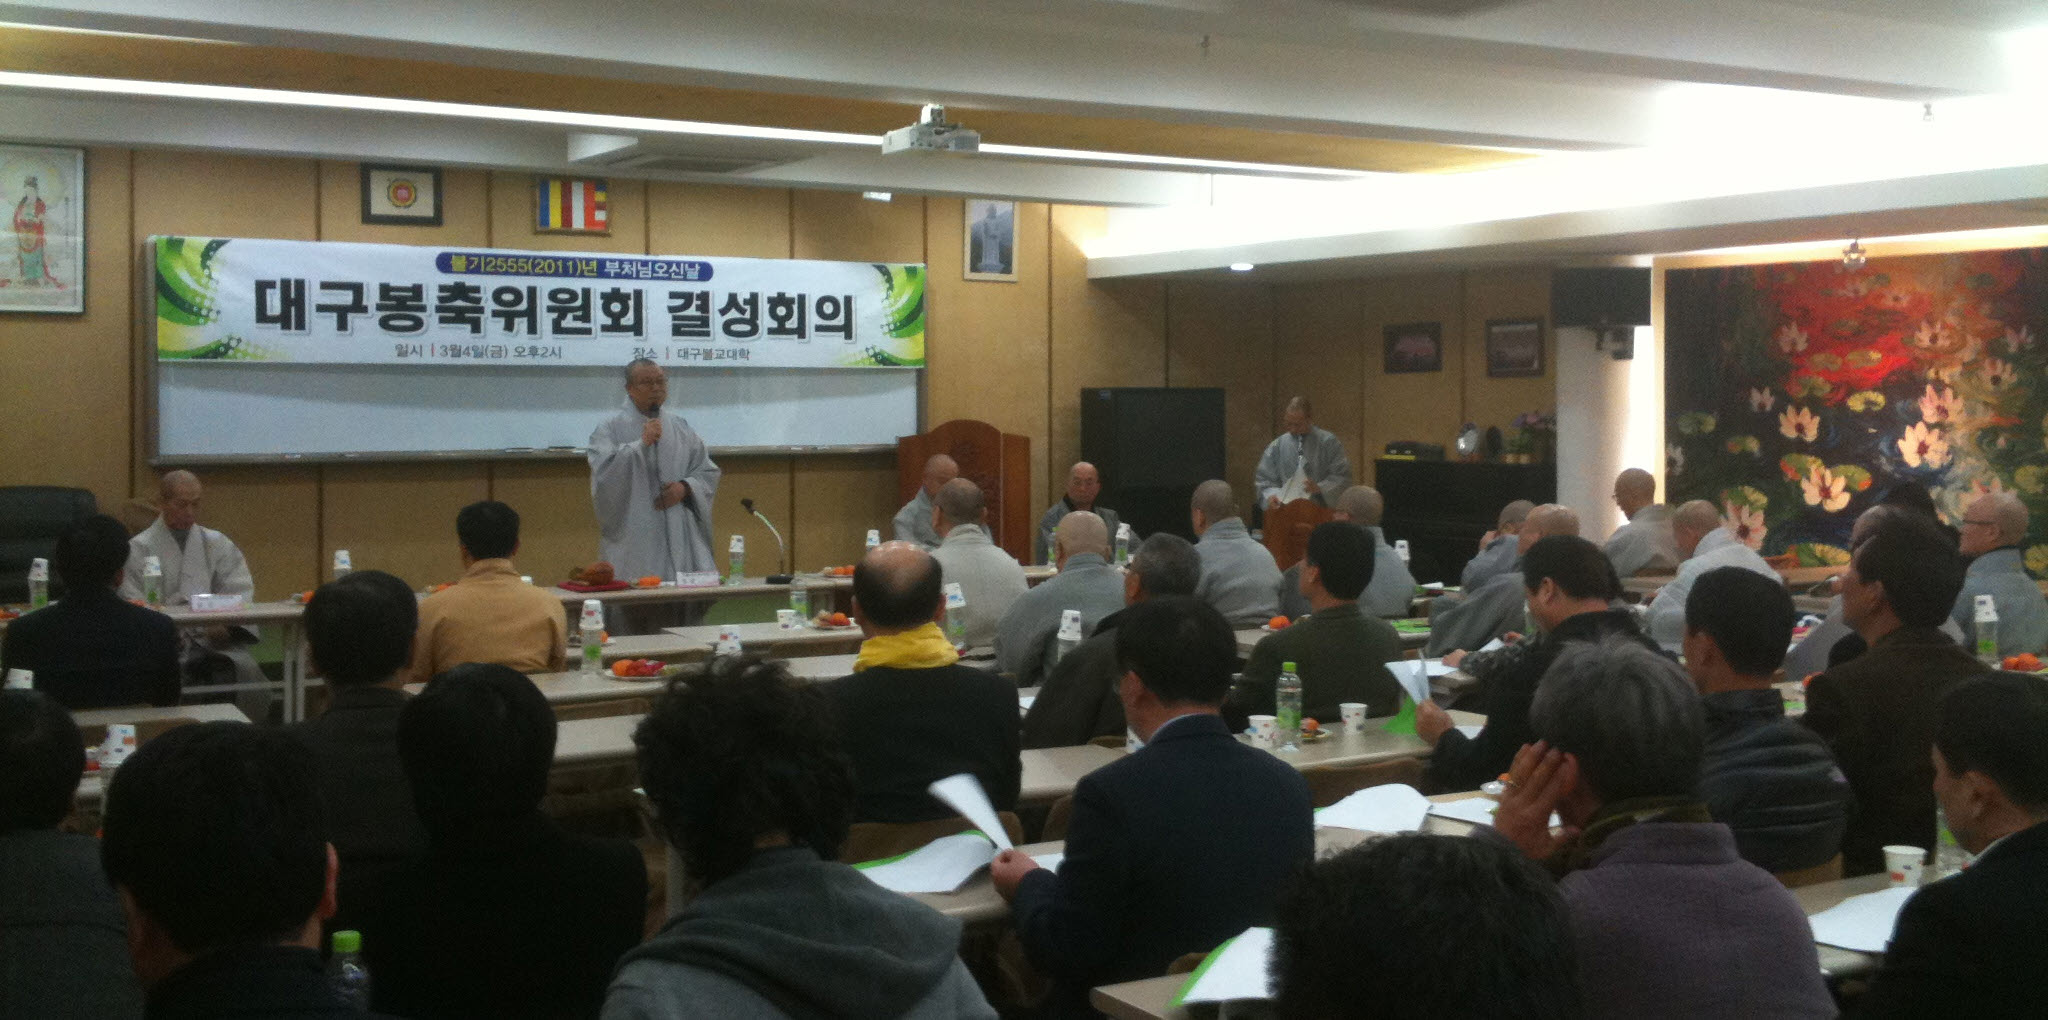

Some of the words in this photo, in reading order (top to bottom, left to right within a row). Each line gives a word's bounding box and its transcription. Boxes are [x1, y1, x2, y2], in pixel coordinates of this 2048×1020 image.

[604, 260, 700, 280] 부처님오신날
[255, 277, 644, 337] 대구봉축위원회
[667, 289, 853, 341] 결성회의
[394, 343, 423, 358] 일시
[439, 344, 509, 359] 3월4일(금)
[513, 346, 562, 359] 오후2시
[633, 346, 658, 361] 장소
[677, 348, 750, 361] 대구불교대학
